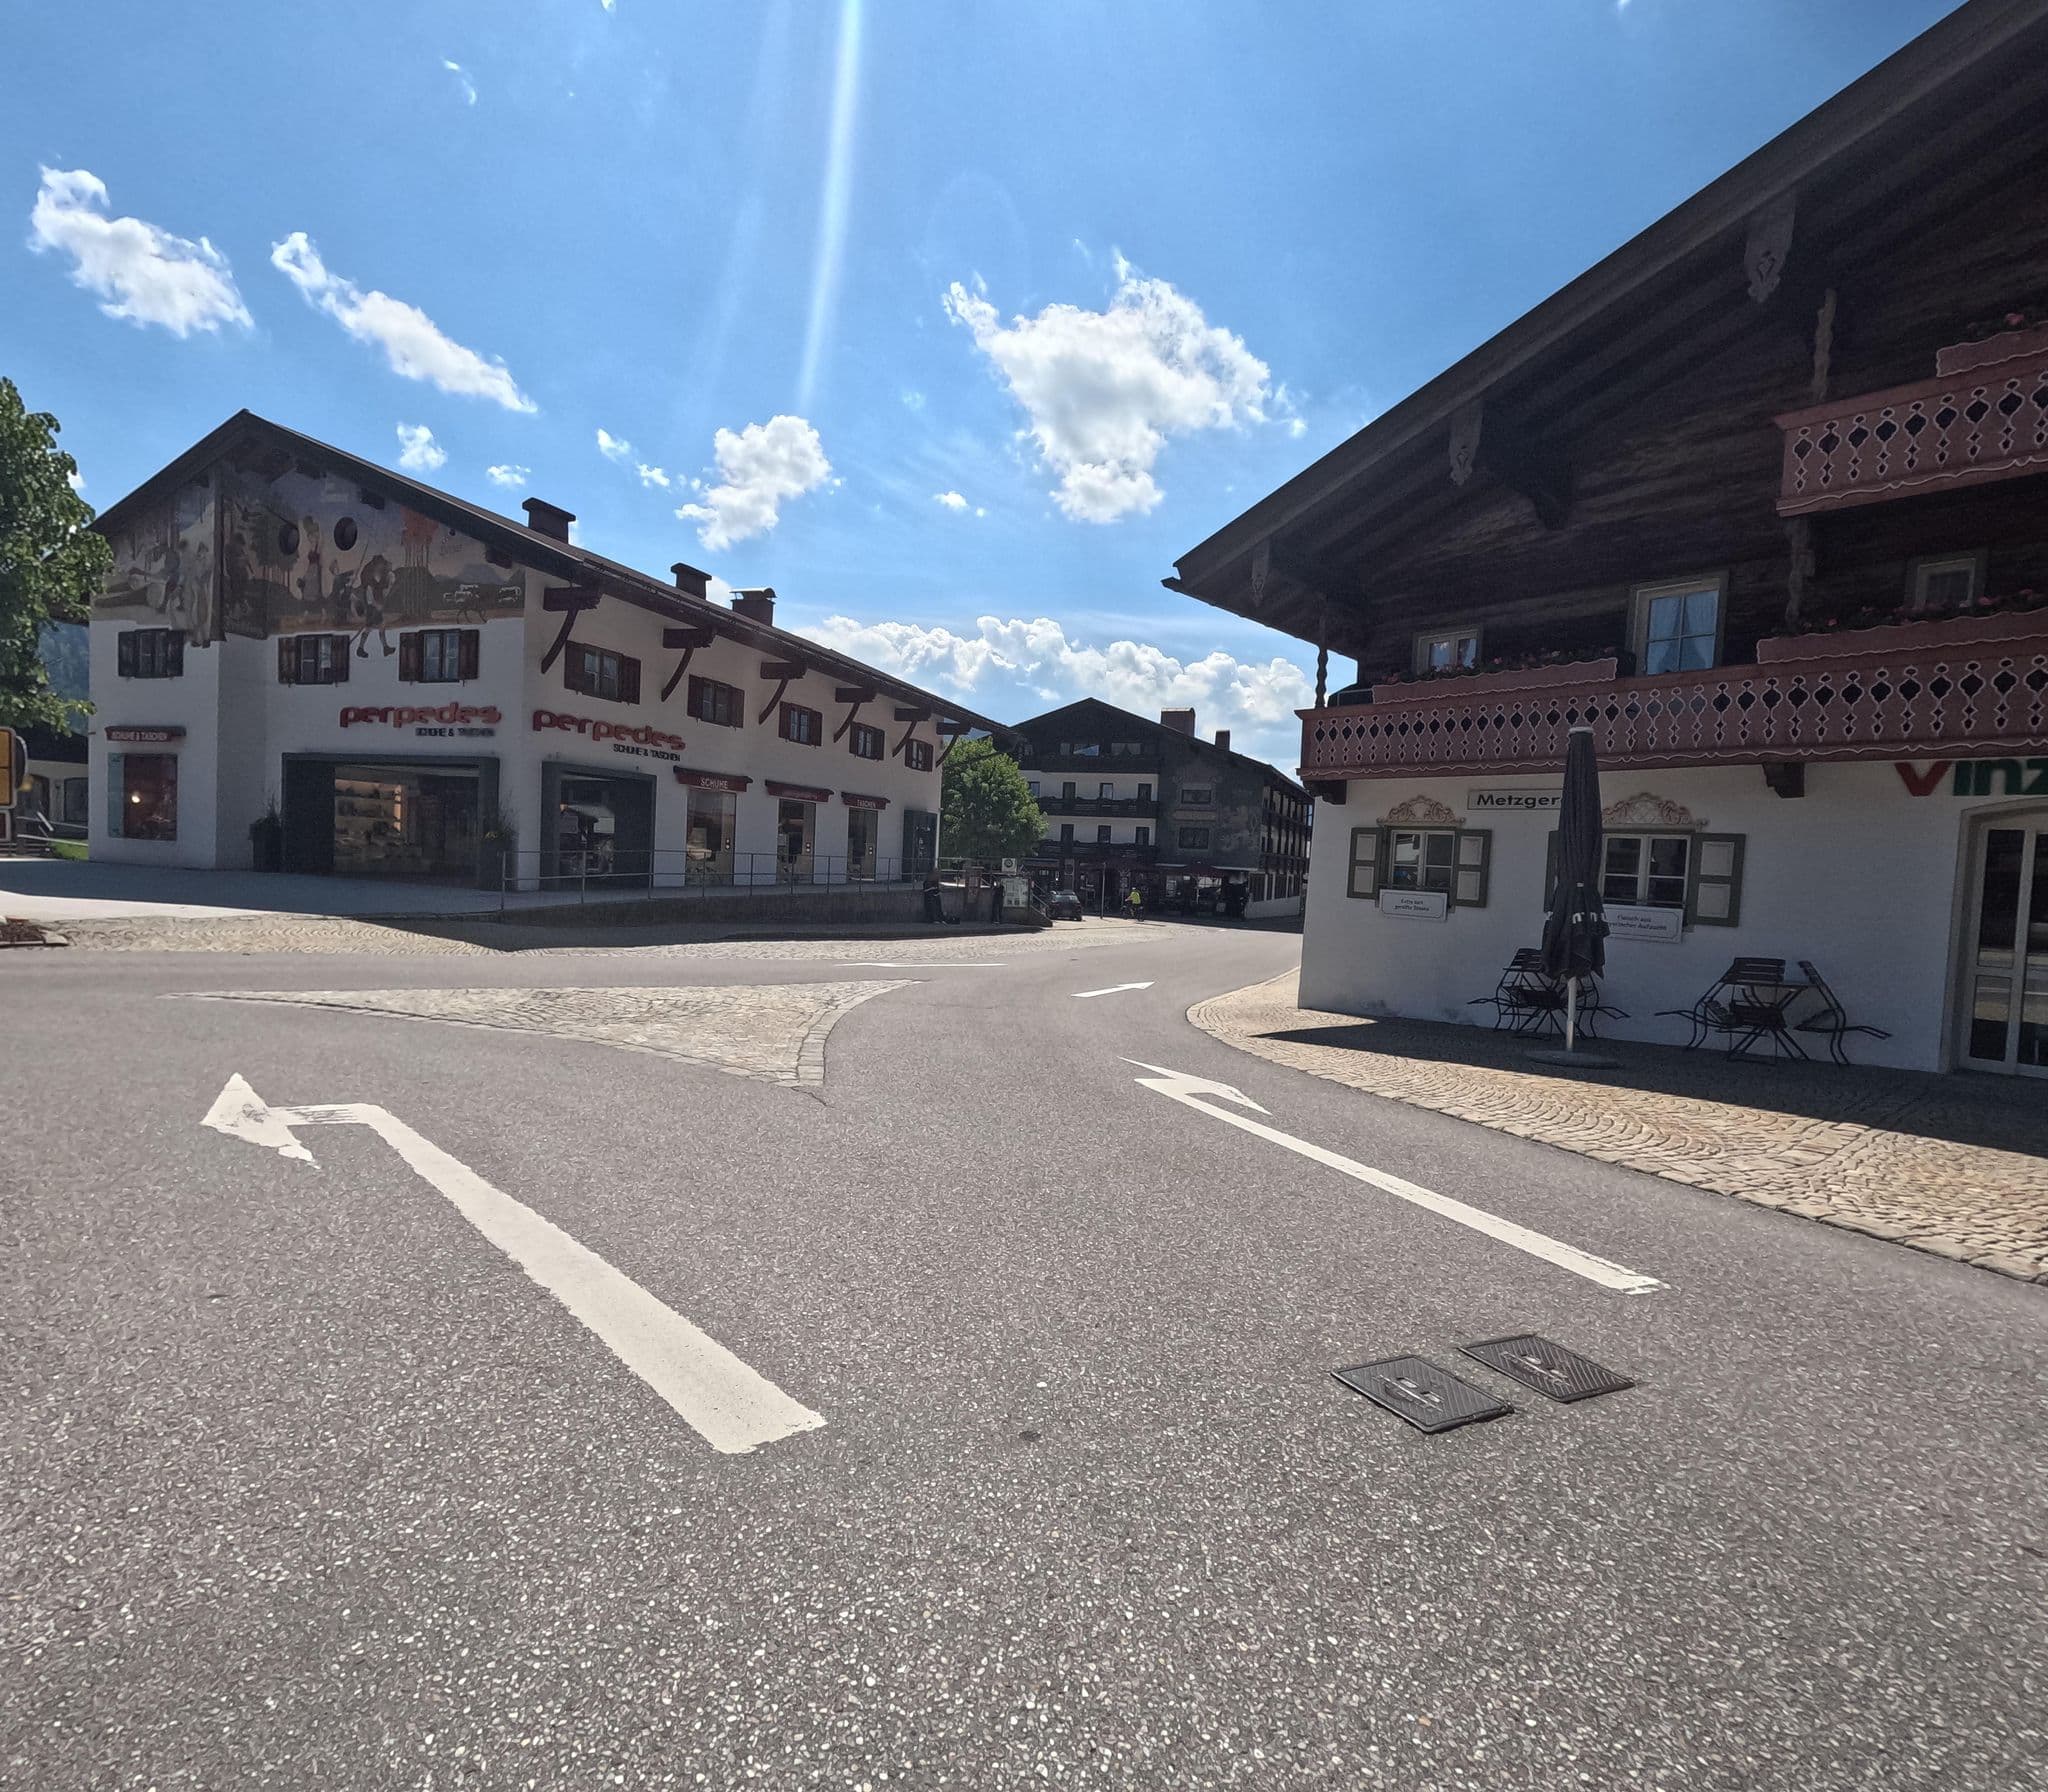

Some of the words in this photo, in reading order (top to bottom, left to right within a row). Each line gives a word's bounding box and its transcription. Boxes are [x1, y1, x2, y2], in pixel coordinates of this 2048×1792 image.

[339, 702, 502, 728] perpedes
[532, 709, 687, 751] perpedes
[700, 777, 729, 790] SCHUHE
